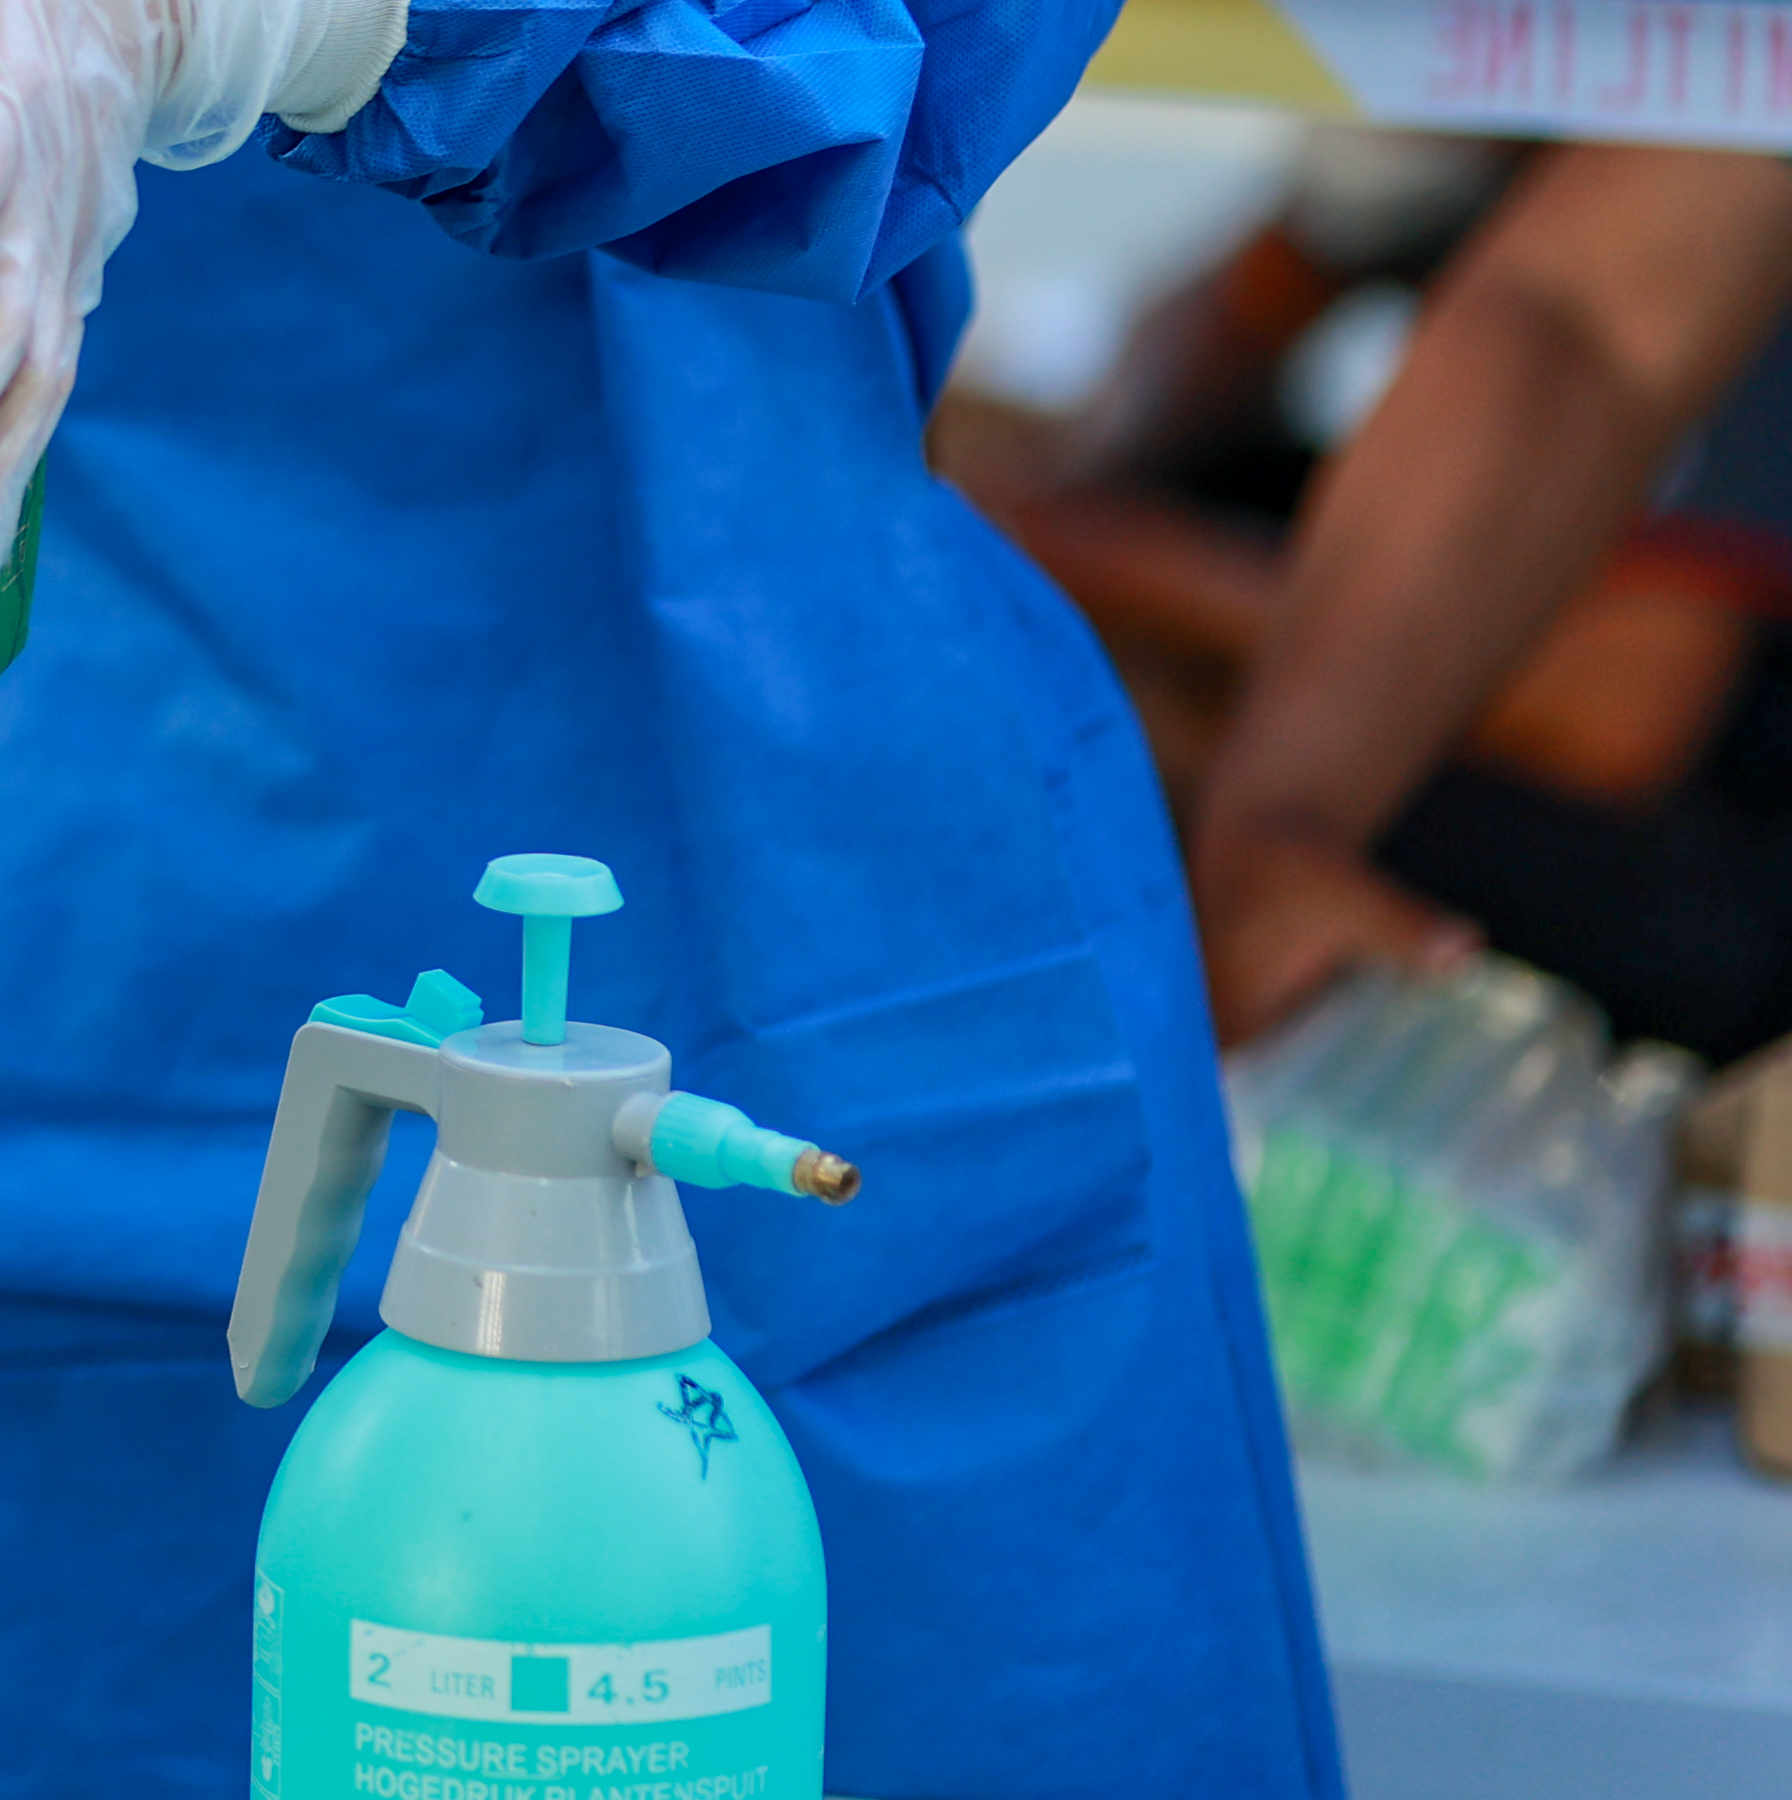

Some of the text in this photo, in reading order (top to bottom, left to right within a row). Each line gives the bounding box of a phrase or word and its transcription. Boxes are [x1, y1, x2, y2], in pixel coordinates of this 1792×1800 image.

[365, 1652, 768, 1706] 2 LITER 4.5 PINTS
[354, 1721, 690, 1778] PRESSURE SPRAYER
